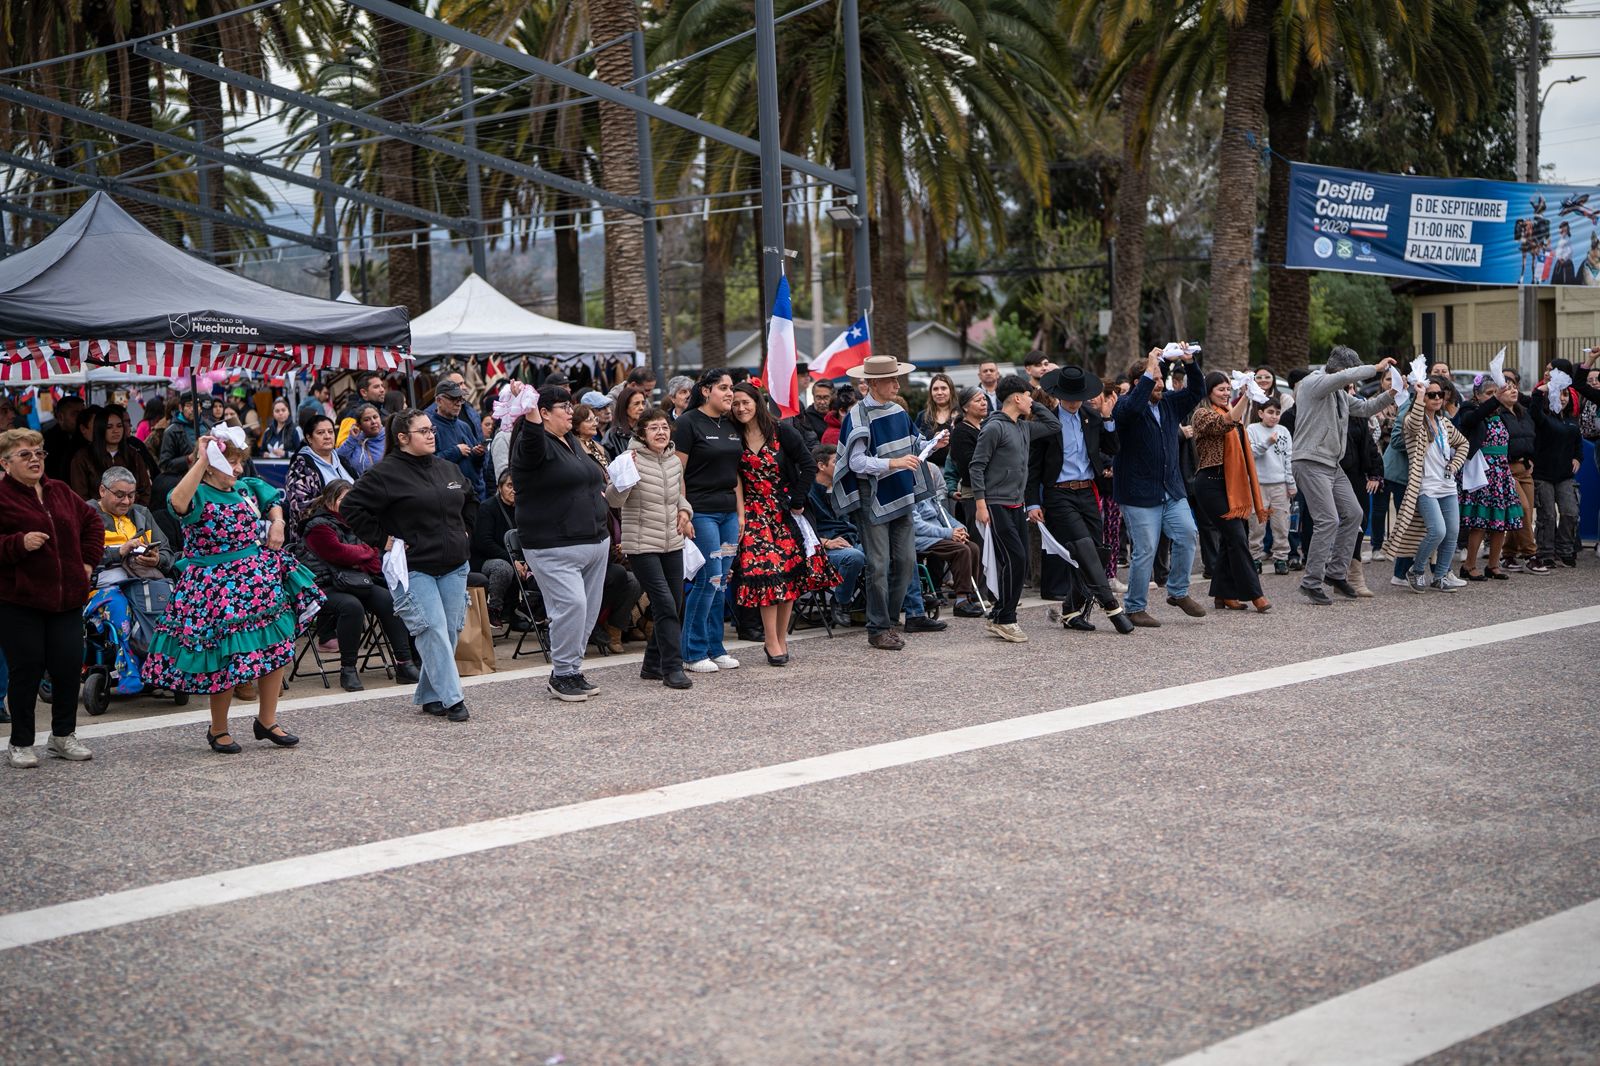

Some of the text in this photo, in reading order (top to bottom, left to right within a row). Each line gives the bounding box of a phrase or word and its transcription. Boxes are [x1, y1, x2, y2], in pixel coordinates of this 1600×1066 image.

[1316, 179, 1375, 203] Desfile
[1315, 198, 1390, 222] Comunal
[1416, 198, 1502, 217] 6 DE SEPTIEMBRE
[1414, 221, 1467, 239] 11:00 HRS.
[1410, 244, 1477, 262] PLAZA CÍVICA
